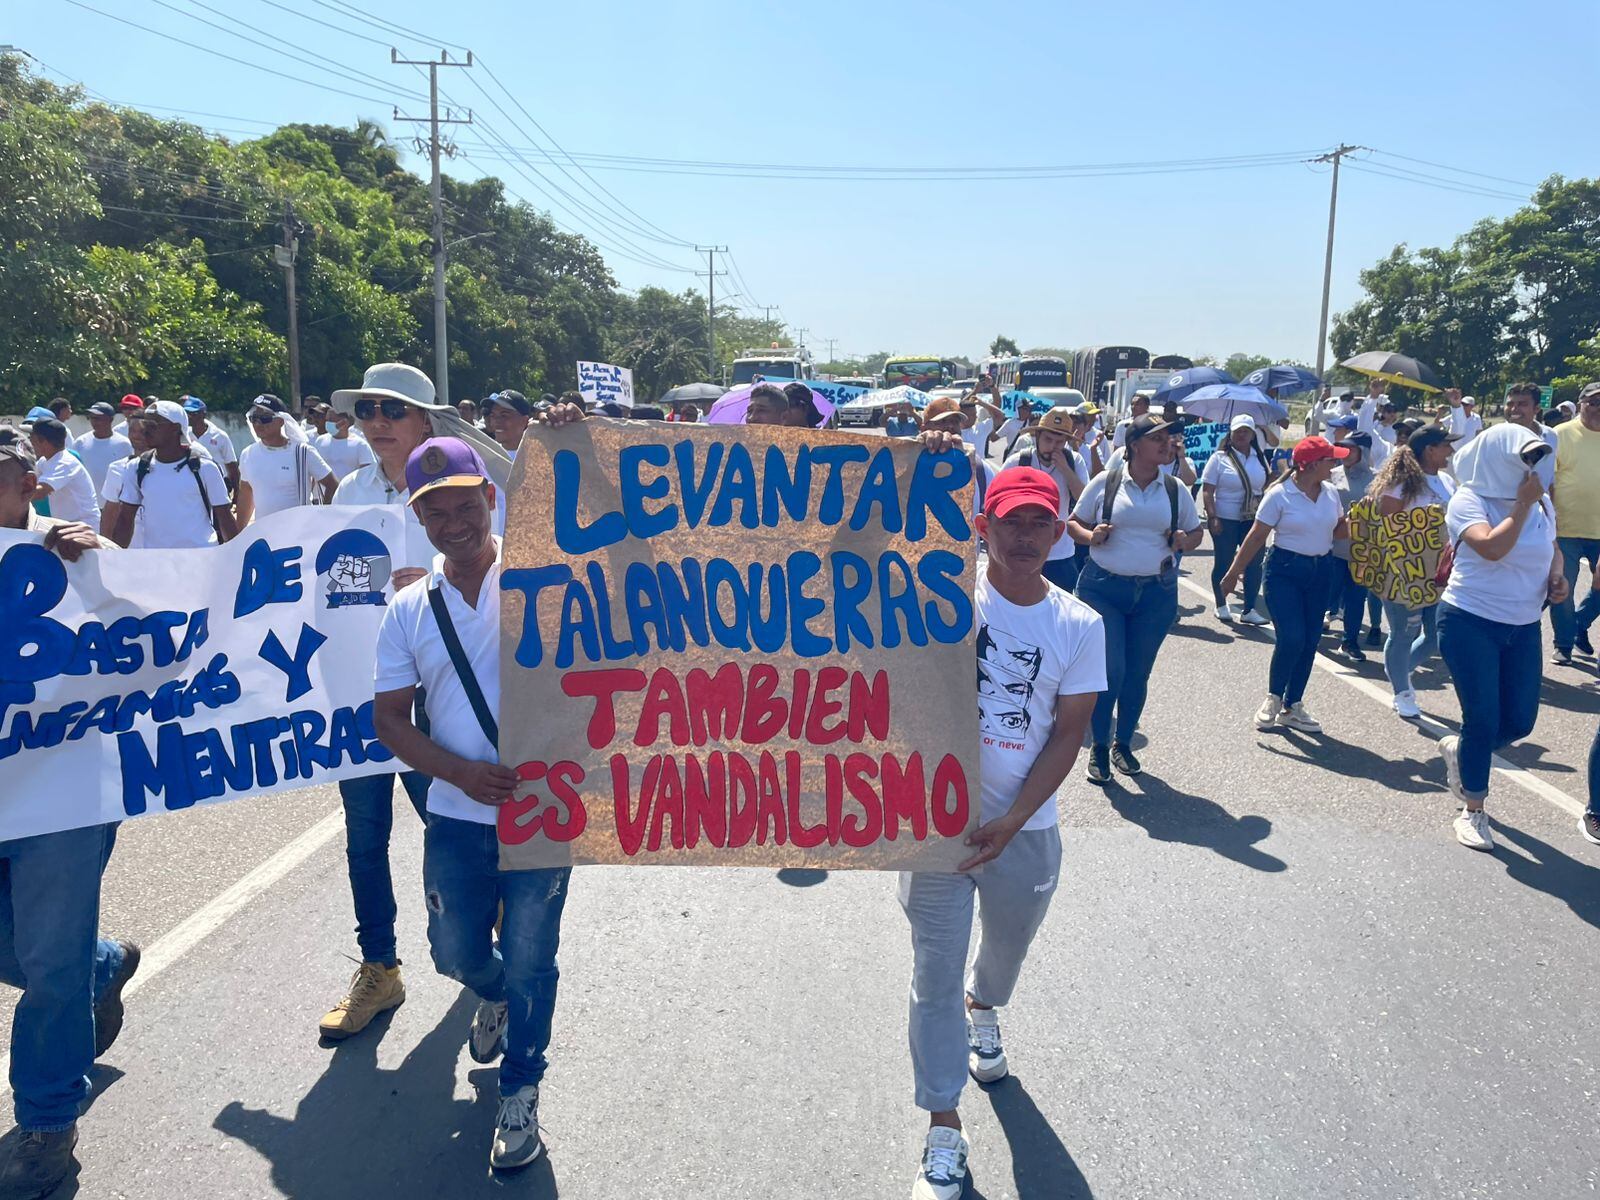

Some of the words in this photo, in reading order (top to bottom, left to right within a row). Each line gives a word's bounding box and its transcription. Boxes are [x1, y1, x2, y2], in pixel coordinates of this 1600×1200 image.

[554, 440, 973, 555] LEVANTAR
[1350, 562, 1385, 593] LOS
[1387, 528, 1443, 559] QUE
[0, 543, 209, 685] BASTA
[233, 539, 303, 619] DE
[500, 550, 973, 668] TALANQUERAS
[259, 622, 327, 702] Y
[560, 662, 889, 749] TAMBIEN
[983, 737, 996, 746] or
[998, 740, 1026, 750] never
[498, 760, 588, 845] ES
[610, 750, 969, 856] VANDALISMO
